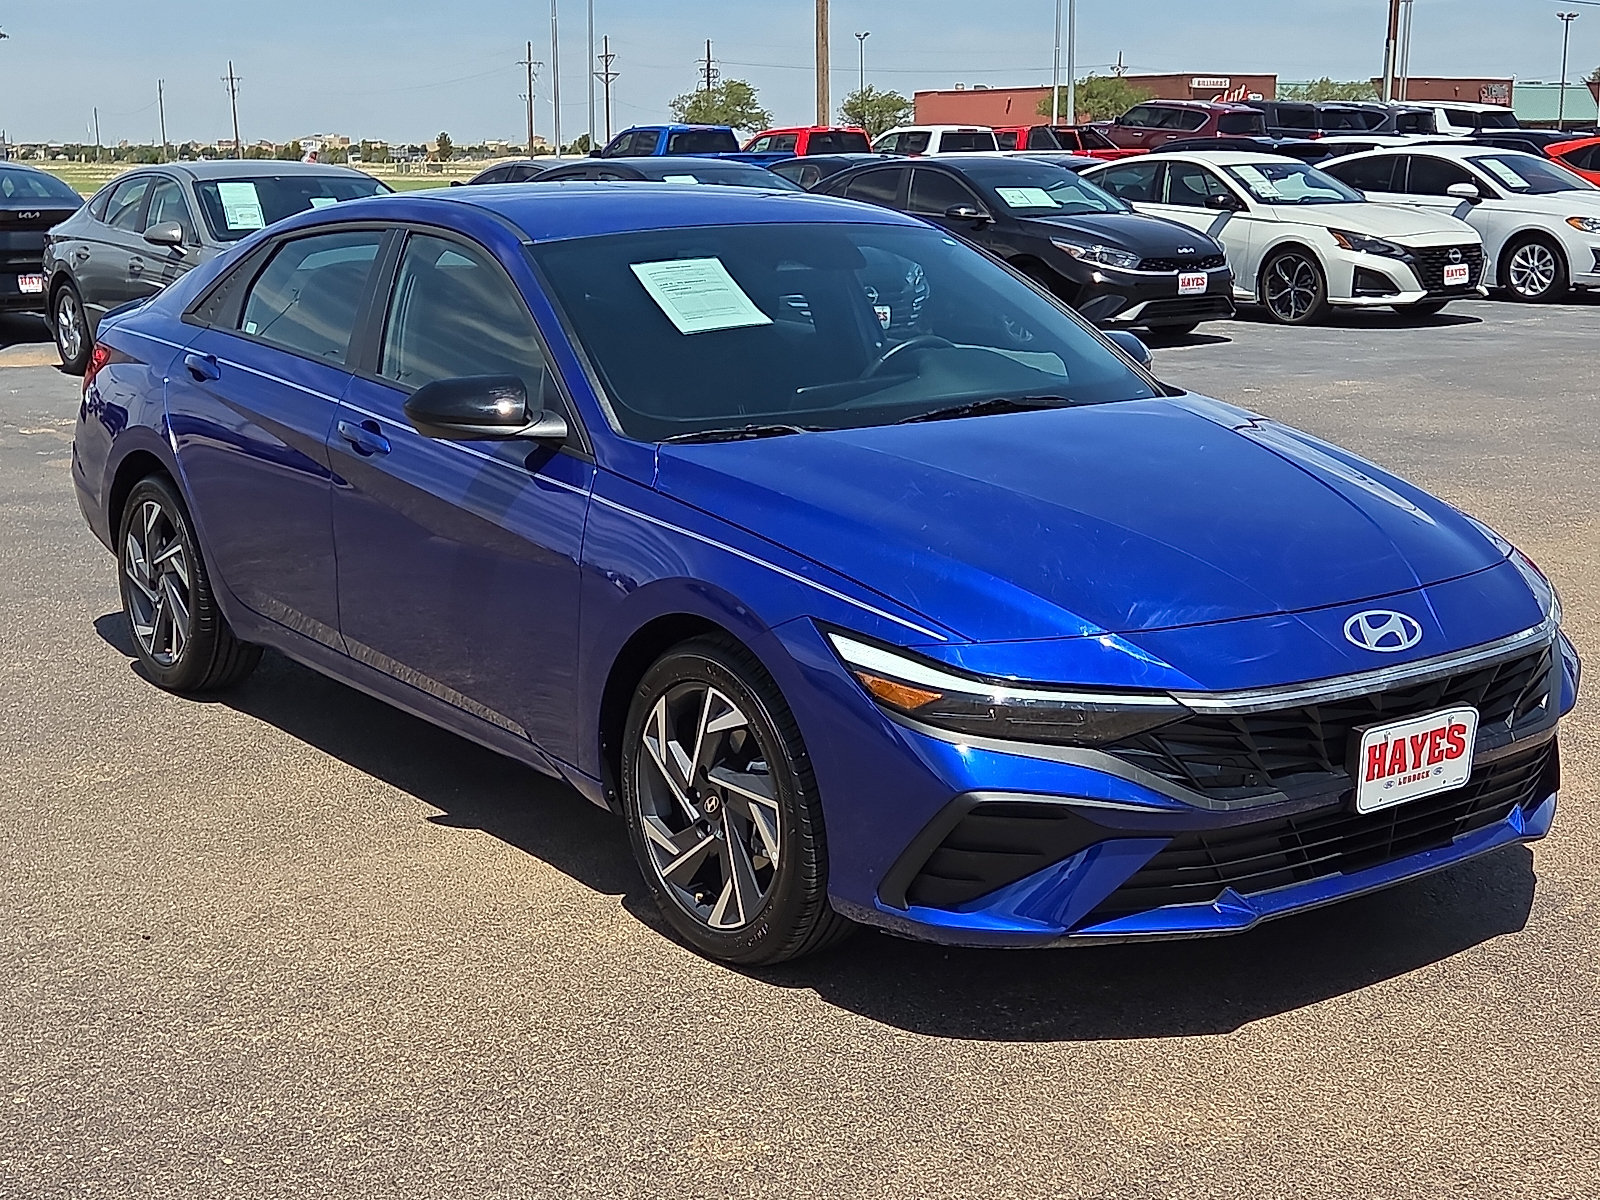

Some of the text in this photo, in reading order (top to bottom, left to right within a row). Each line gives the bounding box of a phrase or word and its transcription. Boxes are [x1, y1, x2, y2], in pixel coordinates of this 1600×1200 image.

[20, 276, 42, 286] HAY
[1181, 277, 1206, 287] HAYES
[1365, 723, 1467, 782] HAYES
[1398, 770, 1431, 786] LUBBOCK
